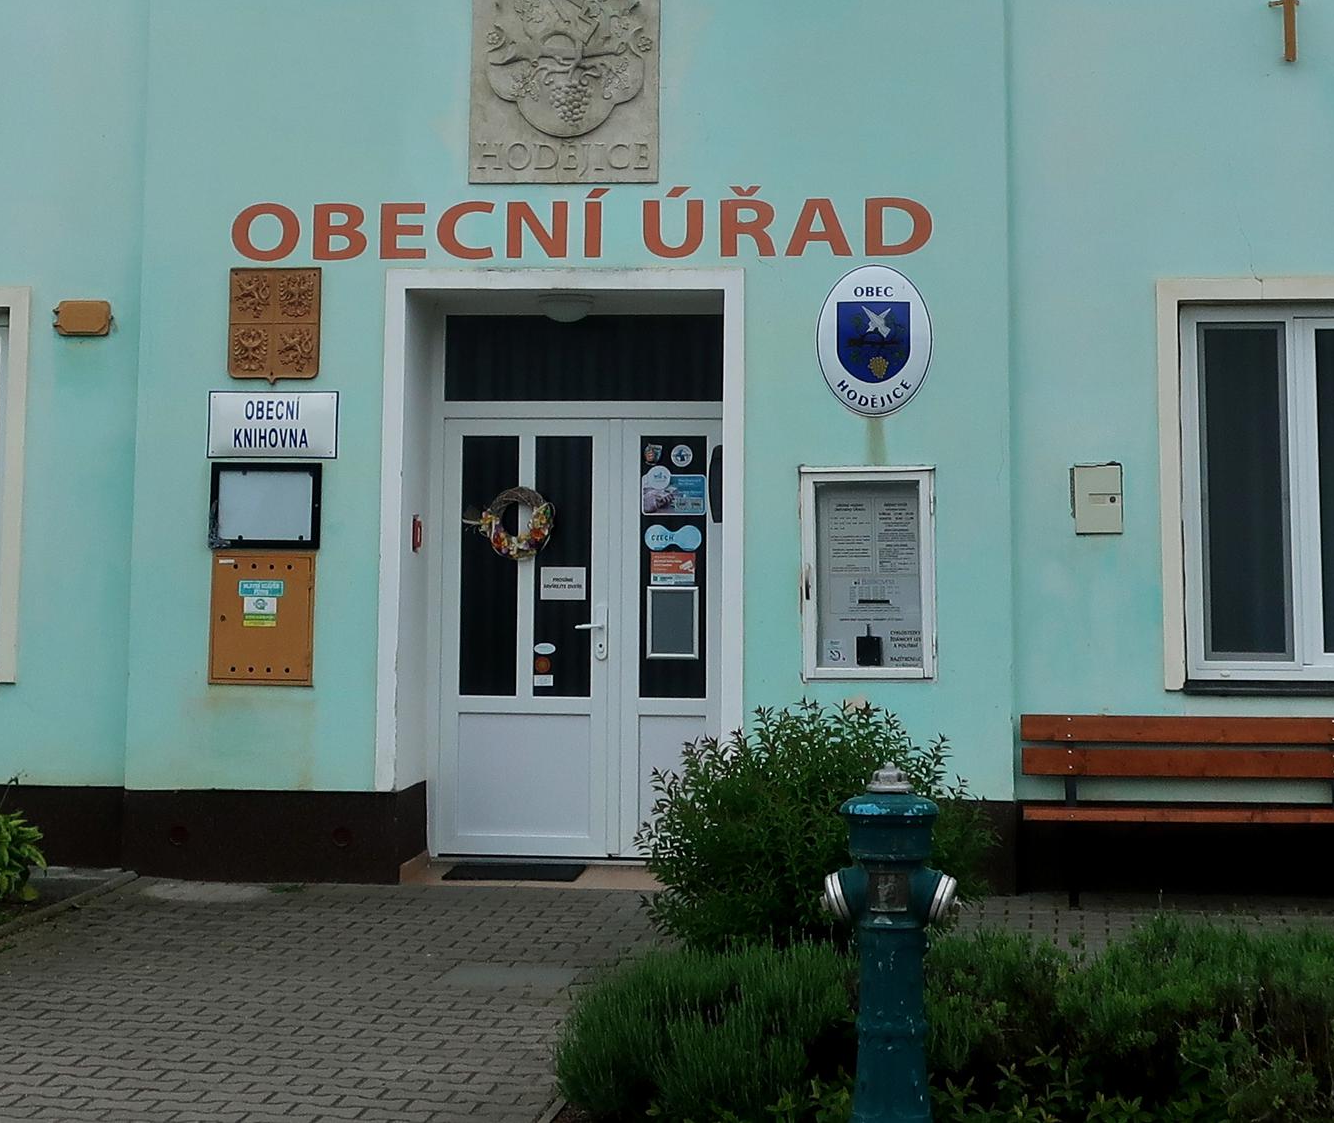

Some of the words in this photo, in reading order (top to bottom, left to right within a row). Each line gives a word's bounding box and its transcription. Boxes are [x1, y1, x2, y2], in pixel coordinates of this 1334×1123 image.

[476, 139, 651, 178] HODĚJICE
[230, 188, 611, 262] OBECNÍ
[642, 185, 934, 259] ÚŘAD
[853, 286, 894, 297] OBEC
[837, 379, 912, 408] HODĚJICE
[245, 396, 300, 420] OBECNÍ
[233, 428, 309, 448] KNIHOVNA
